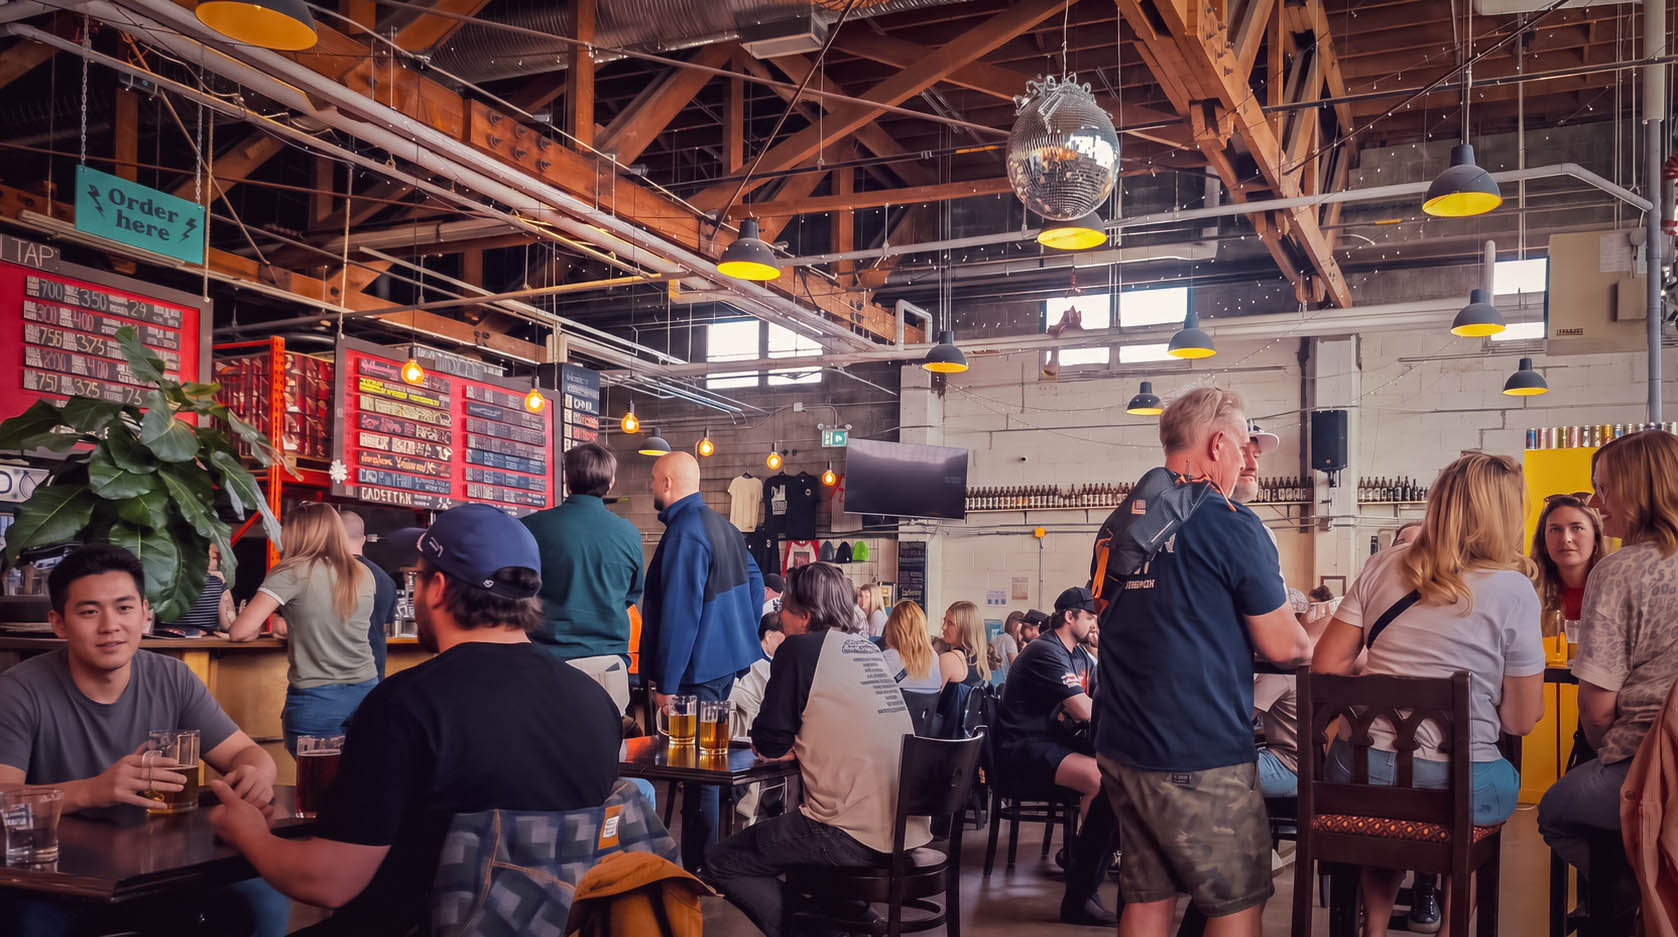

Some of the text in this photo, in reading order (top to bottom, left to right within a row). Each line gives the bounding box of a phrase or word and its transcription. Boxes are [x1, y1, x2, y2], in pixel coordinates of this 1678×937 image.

[108, 188, 178, 223] Order
[115, 209, 170, 241] here
[11, 237, 55, 267] TAP
[40, 279, 63, 299] 700
[81, 289, 107, 310] 350
[77, 335, 104, 355] 375
